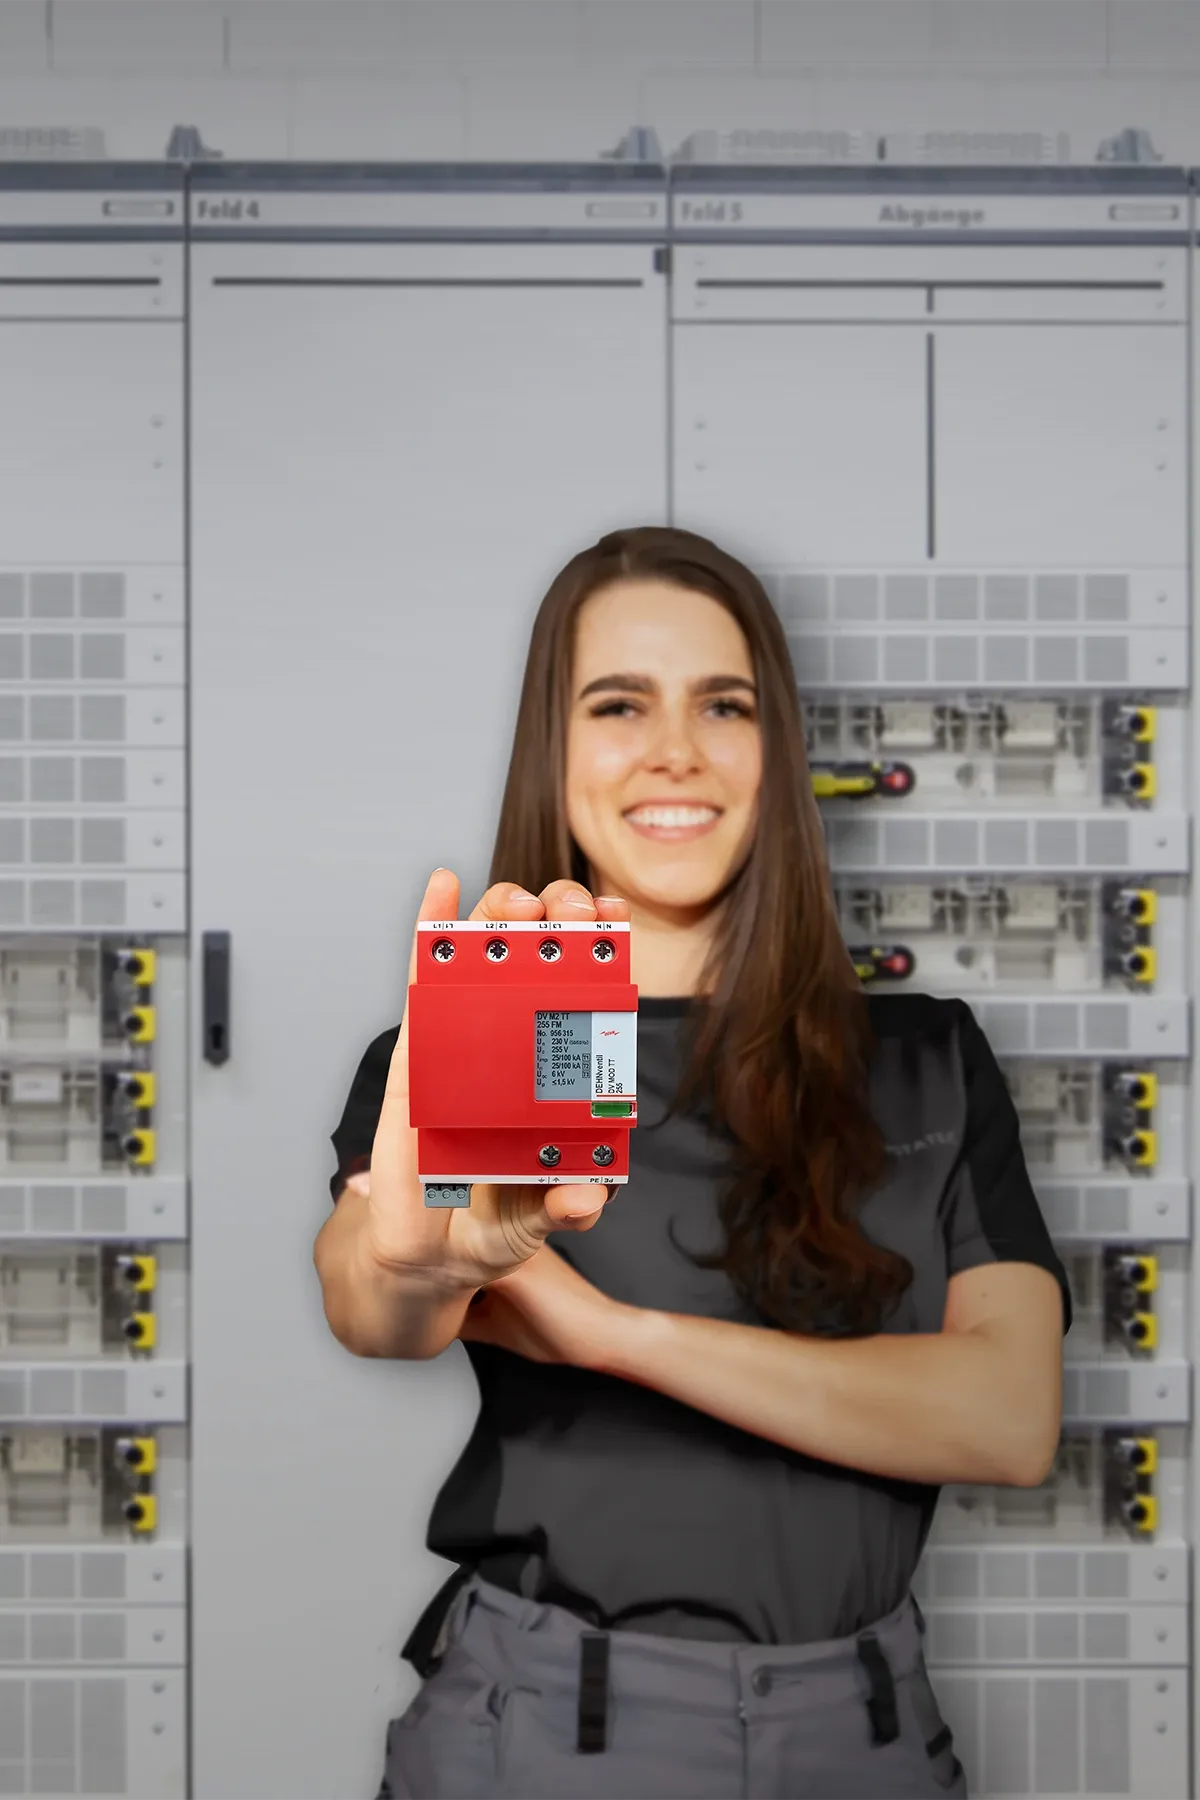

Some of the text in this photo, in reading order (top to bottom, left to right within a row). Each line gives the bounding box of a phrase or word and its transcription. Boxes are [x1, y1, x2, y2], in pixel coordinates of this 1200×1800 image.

[198, 199, 260, 220] Feld 4
[682, 202, 725, 221] Feld
[608, 1059, 615, 1067] TT
[608, 1085, 615, 1093] DV
